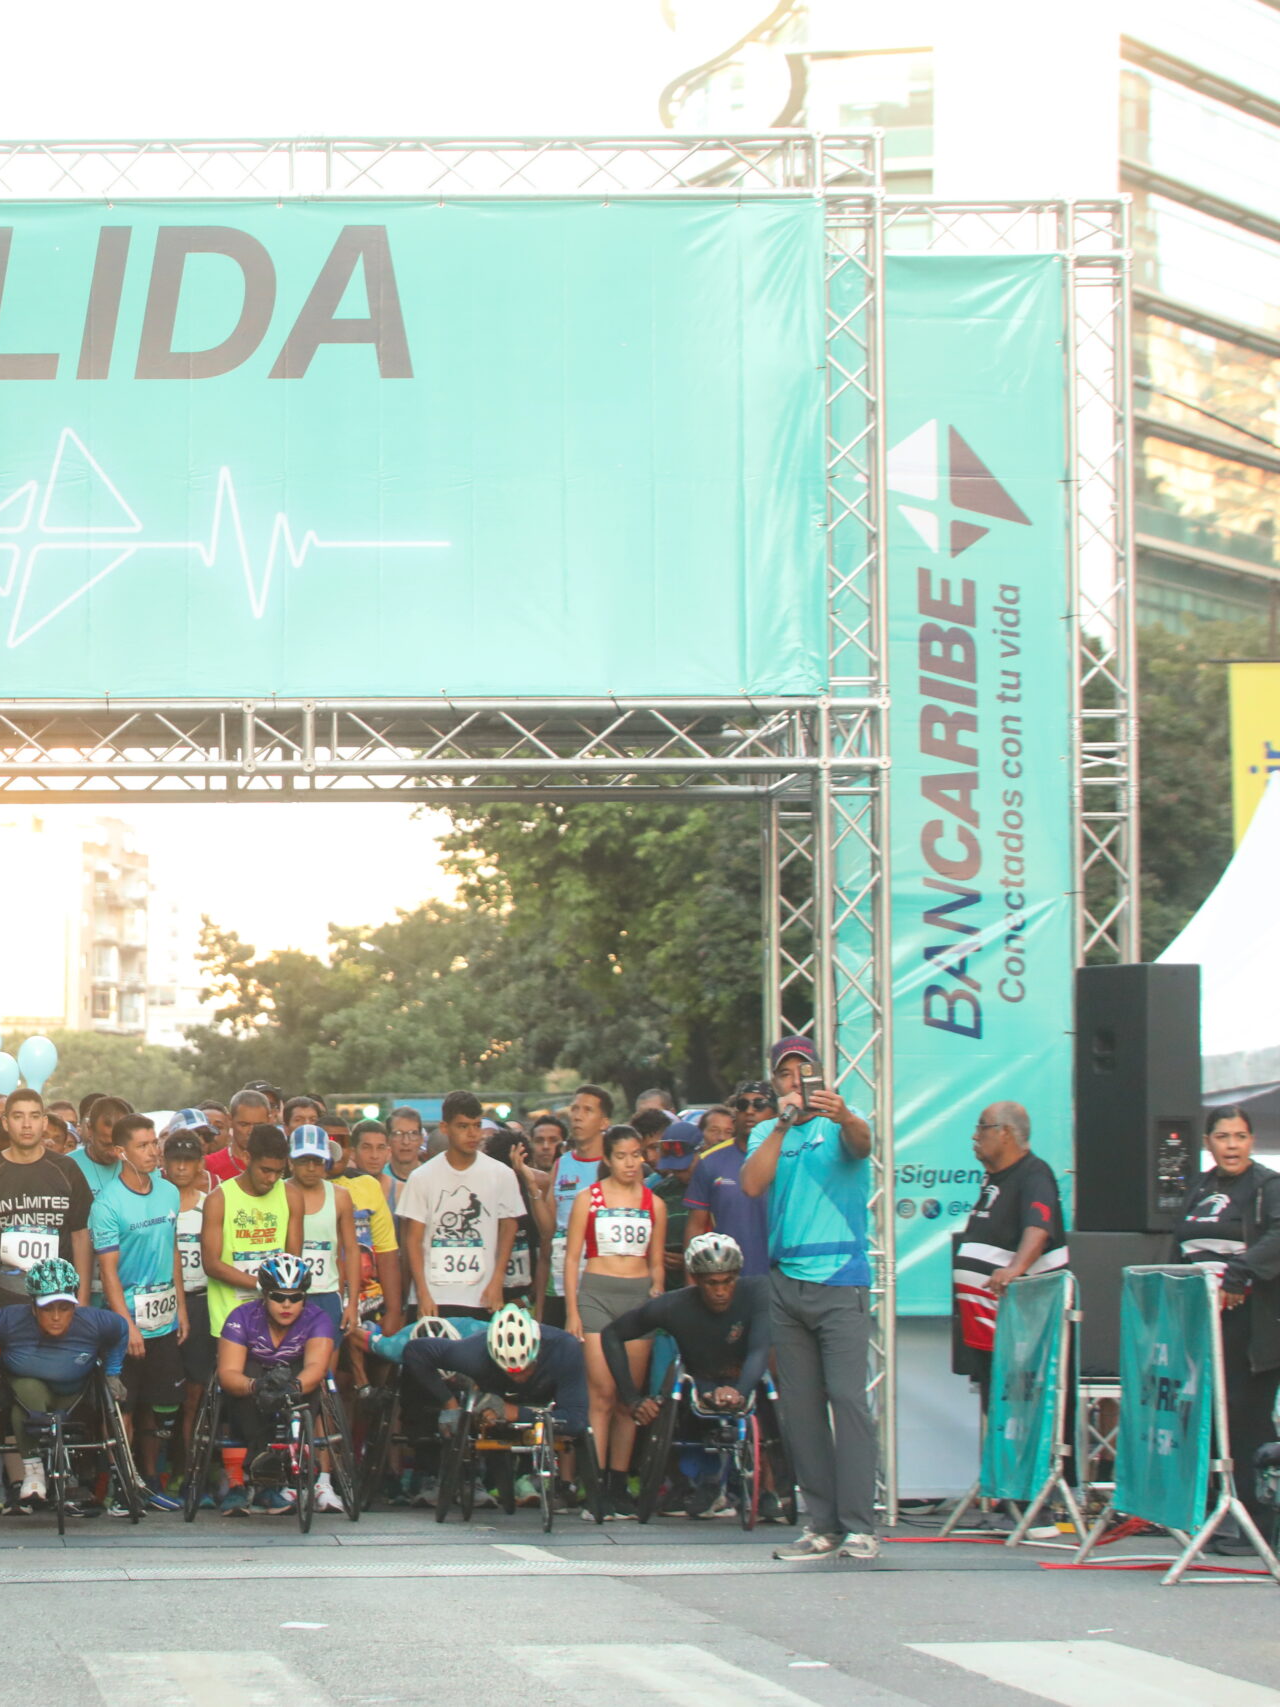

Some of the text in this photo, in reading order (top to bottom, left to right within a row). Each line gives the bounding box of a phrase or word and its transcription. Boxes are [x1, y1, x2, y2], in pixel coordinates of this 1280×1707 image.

[917, 566, 982, 1040] BANCARIBE
[993, 583, 1026, 1004] Conectados con tu vida
[15, 1193, 70, 1209] LÍMITES
[611, 1225, 646, 1244] 388
[18, 1240, 50, 1259] 001
[444, 1255, 480, 1272] 364
[145, 1294, 176, 1319] 1308
